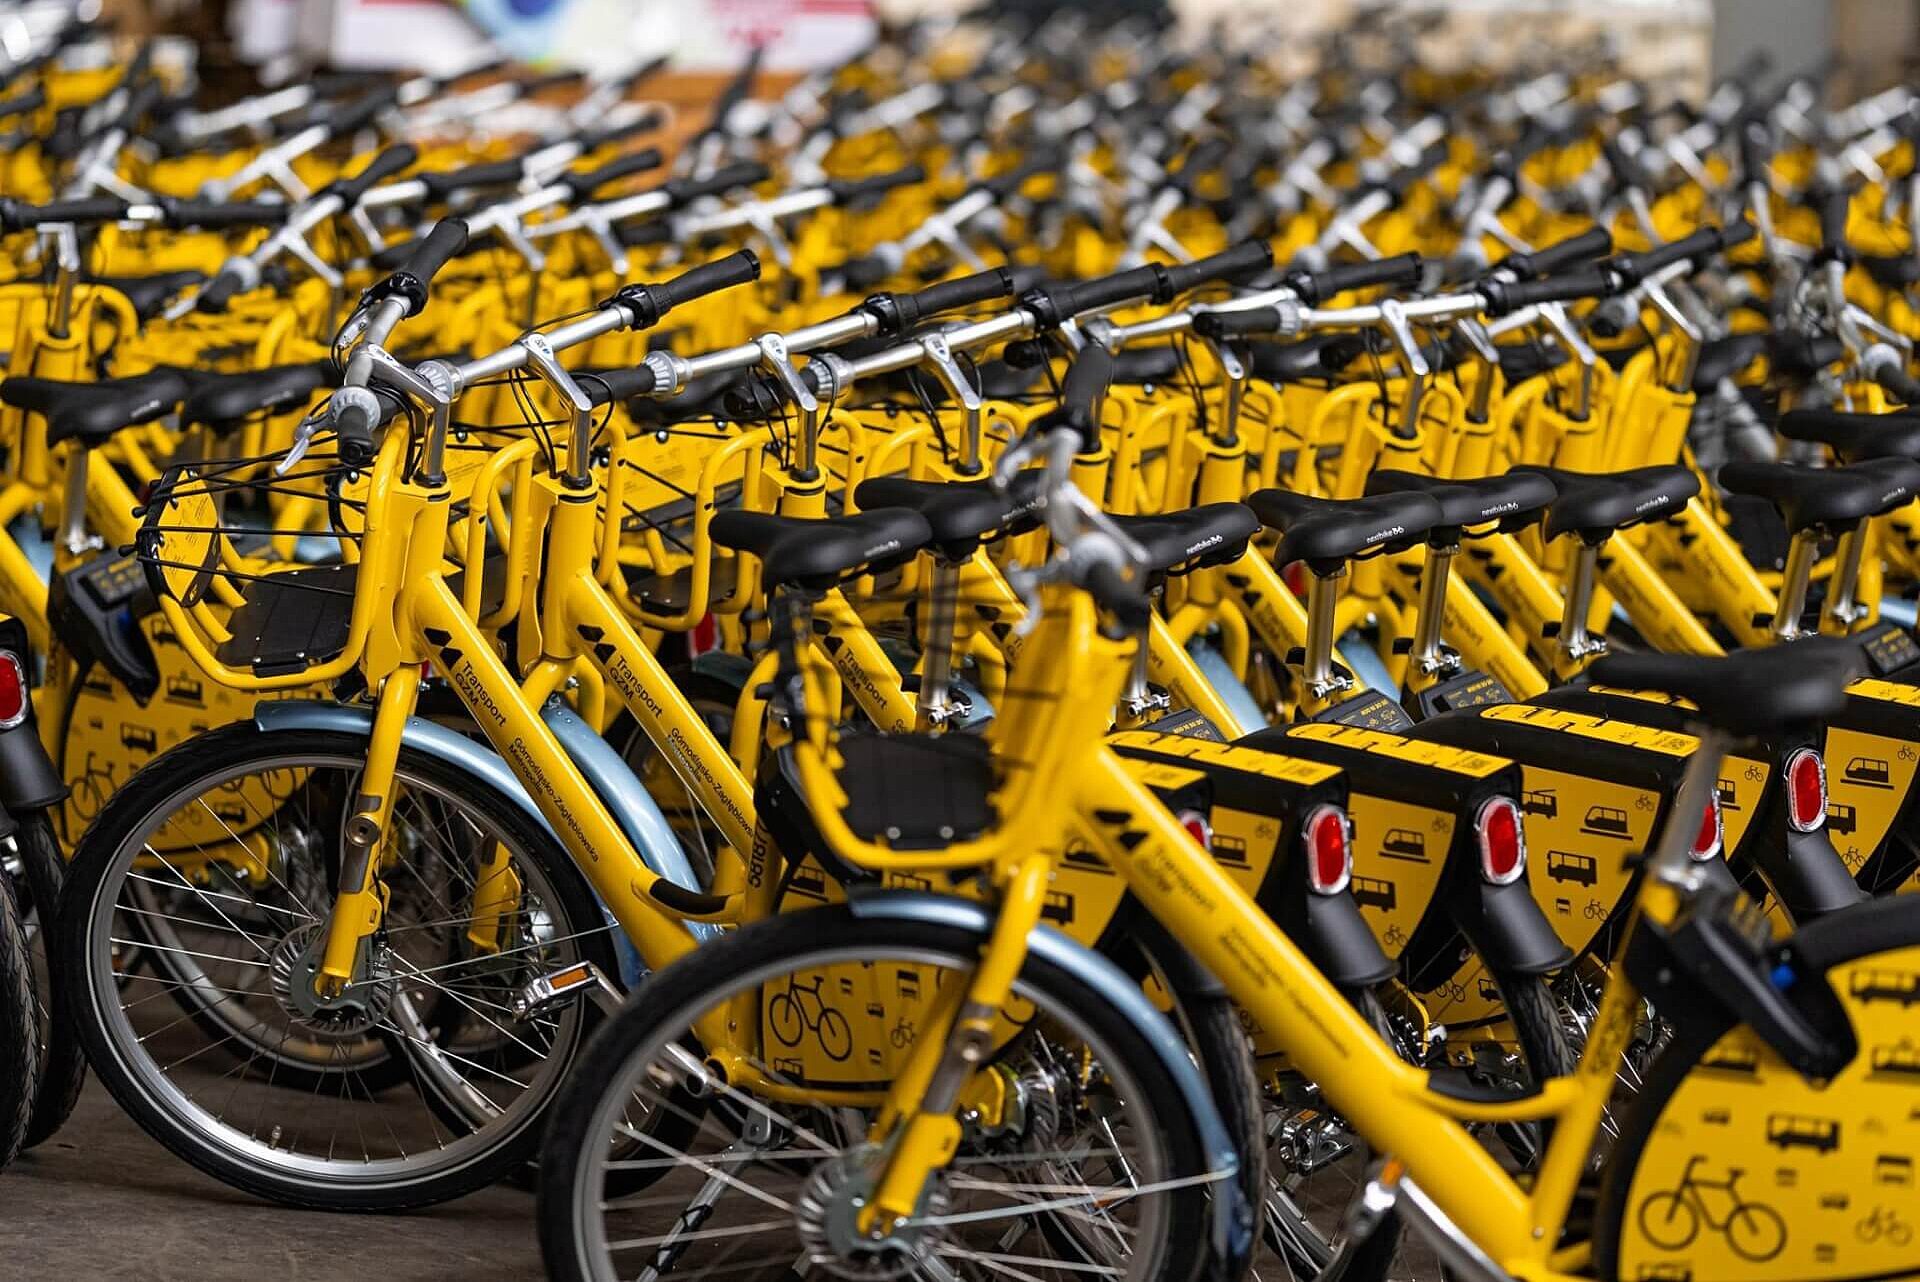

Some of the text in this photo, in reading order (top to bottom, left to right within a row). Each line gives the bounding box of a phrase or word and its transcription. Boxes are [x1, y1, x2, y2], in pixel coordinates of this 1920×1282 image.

[455, 672, 479, 706] GZM
[461, 661, 507, 728] Transport
[608, 667, 635, 701] GZM
[614, 656, 662, 719] Transport
[844, 648, 888, 710] Transport
